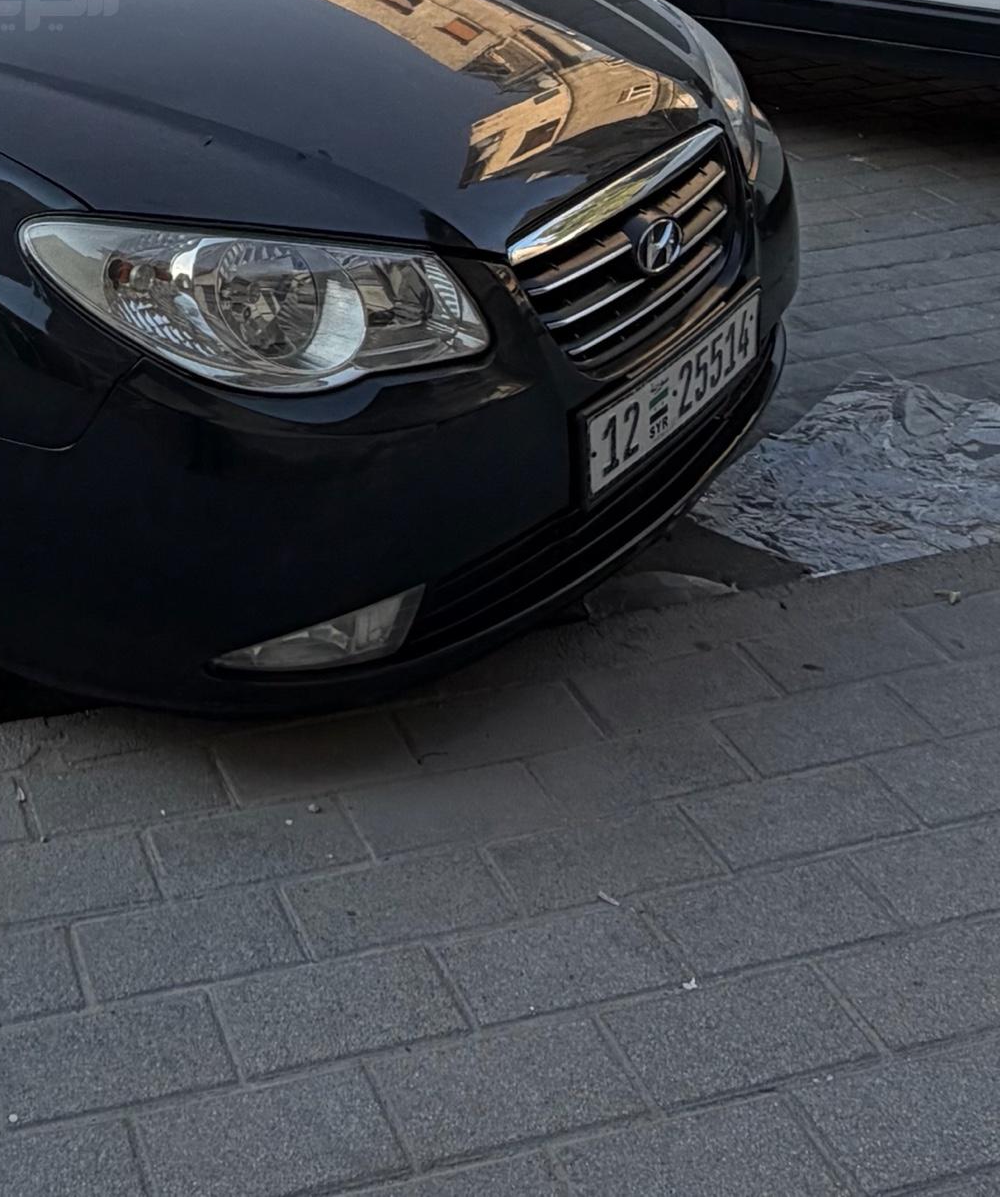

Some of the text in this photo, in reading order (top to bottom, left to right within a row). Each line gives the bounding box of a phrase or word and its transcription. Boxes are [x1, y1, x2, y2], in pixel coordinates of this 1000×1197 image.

[602, 309, 750, 478] 12 25514
[649, 417, 669, 440] SYR
